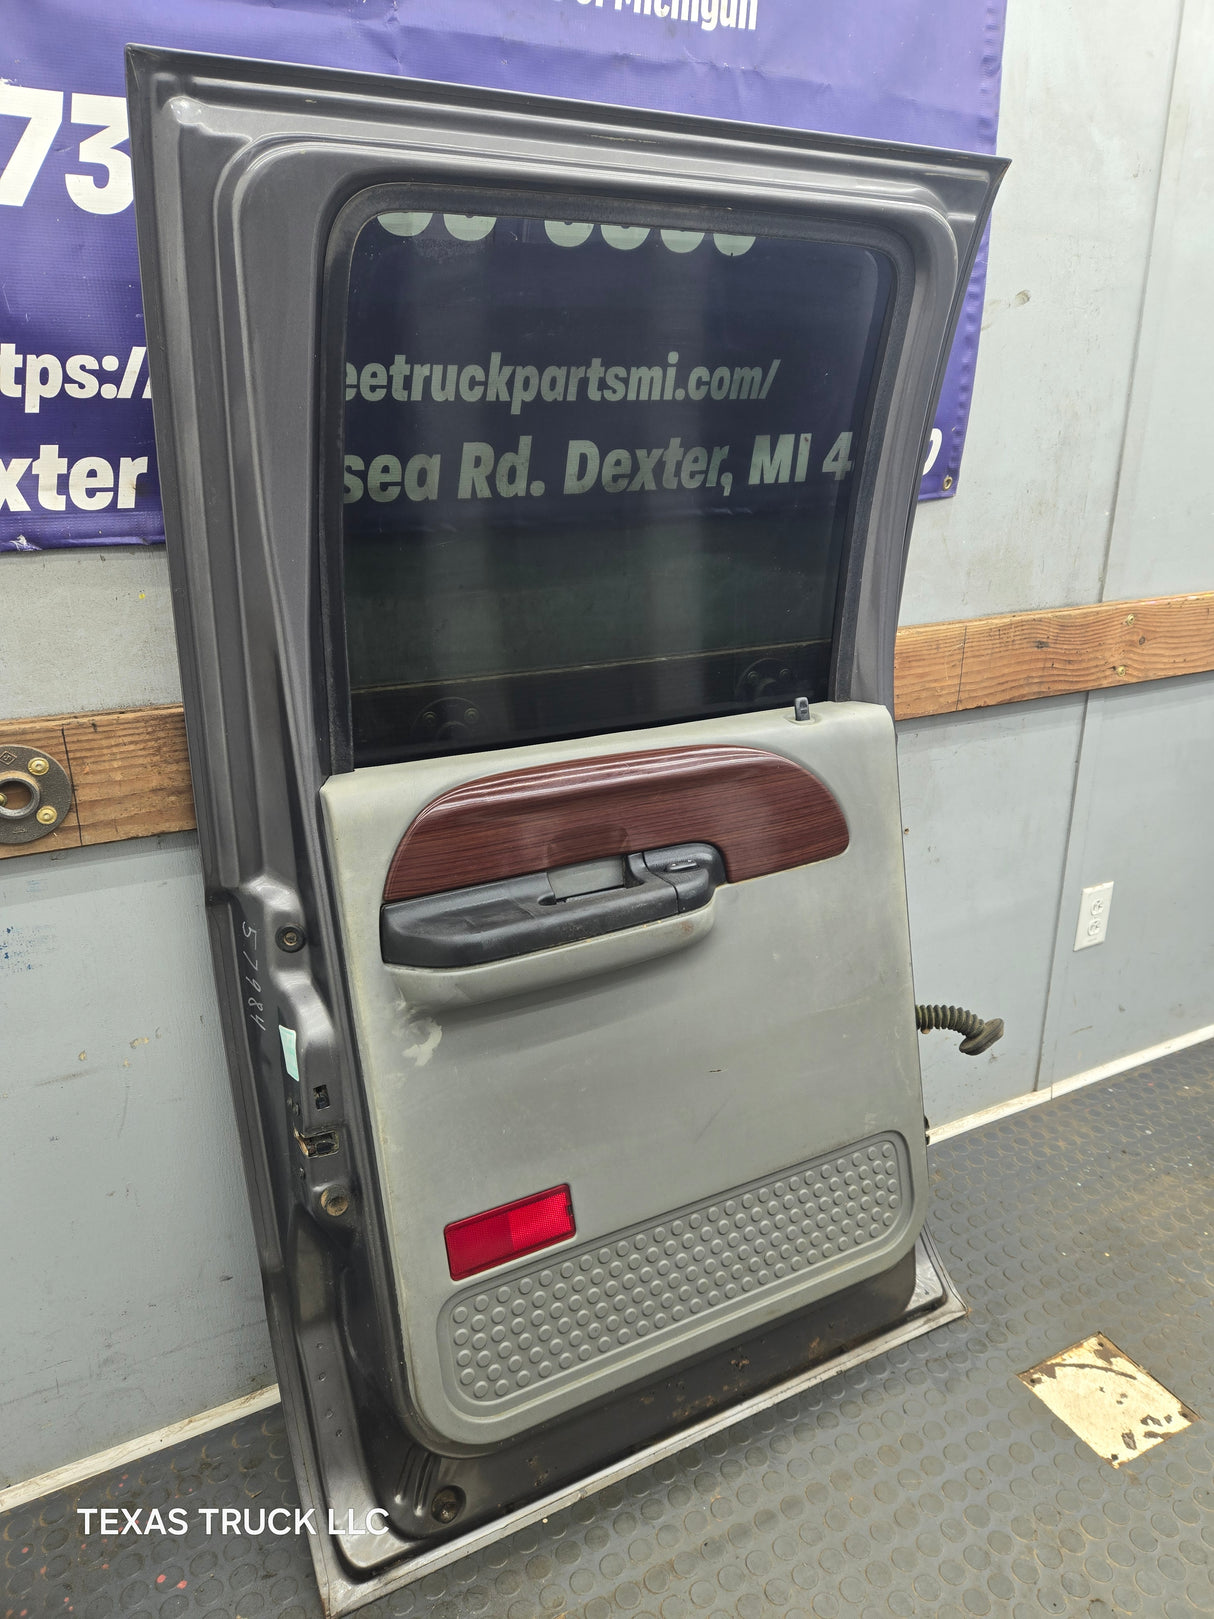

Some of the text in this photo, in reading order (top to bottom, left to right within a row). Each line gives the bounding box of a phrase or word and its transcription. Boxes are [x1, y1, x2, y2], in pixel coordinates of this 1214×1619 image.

[0, 85, 134, 215] 73
[0, 444, 148, 511] xter
[344, 454, 441, 504] sea
[458, 435, 546, 499] Rd.
[563, 437, 733, 496] Dexter,
[748, 433, 812, 485] MI
